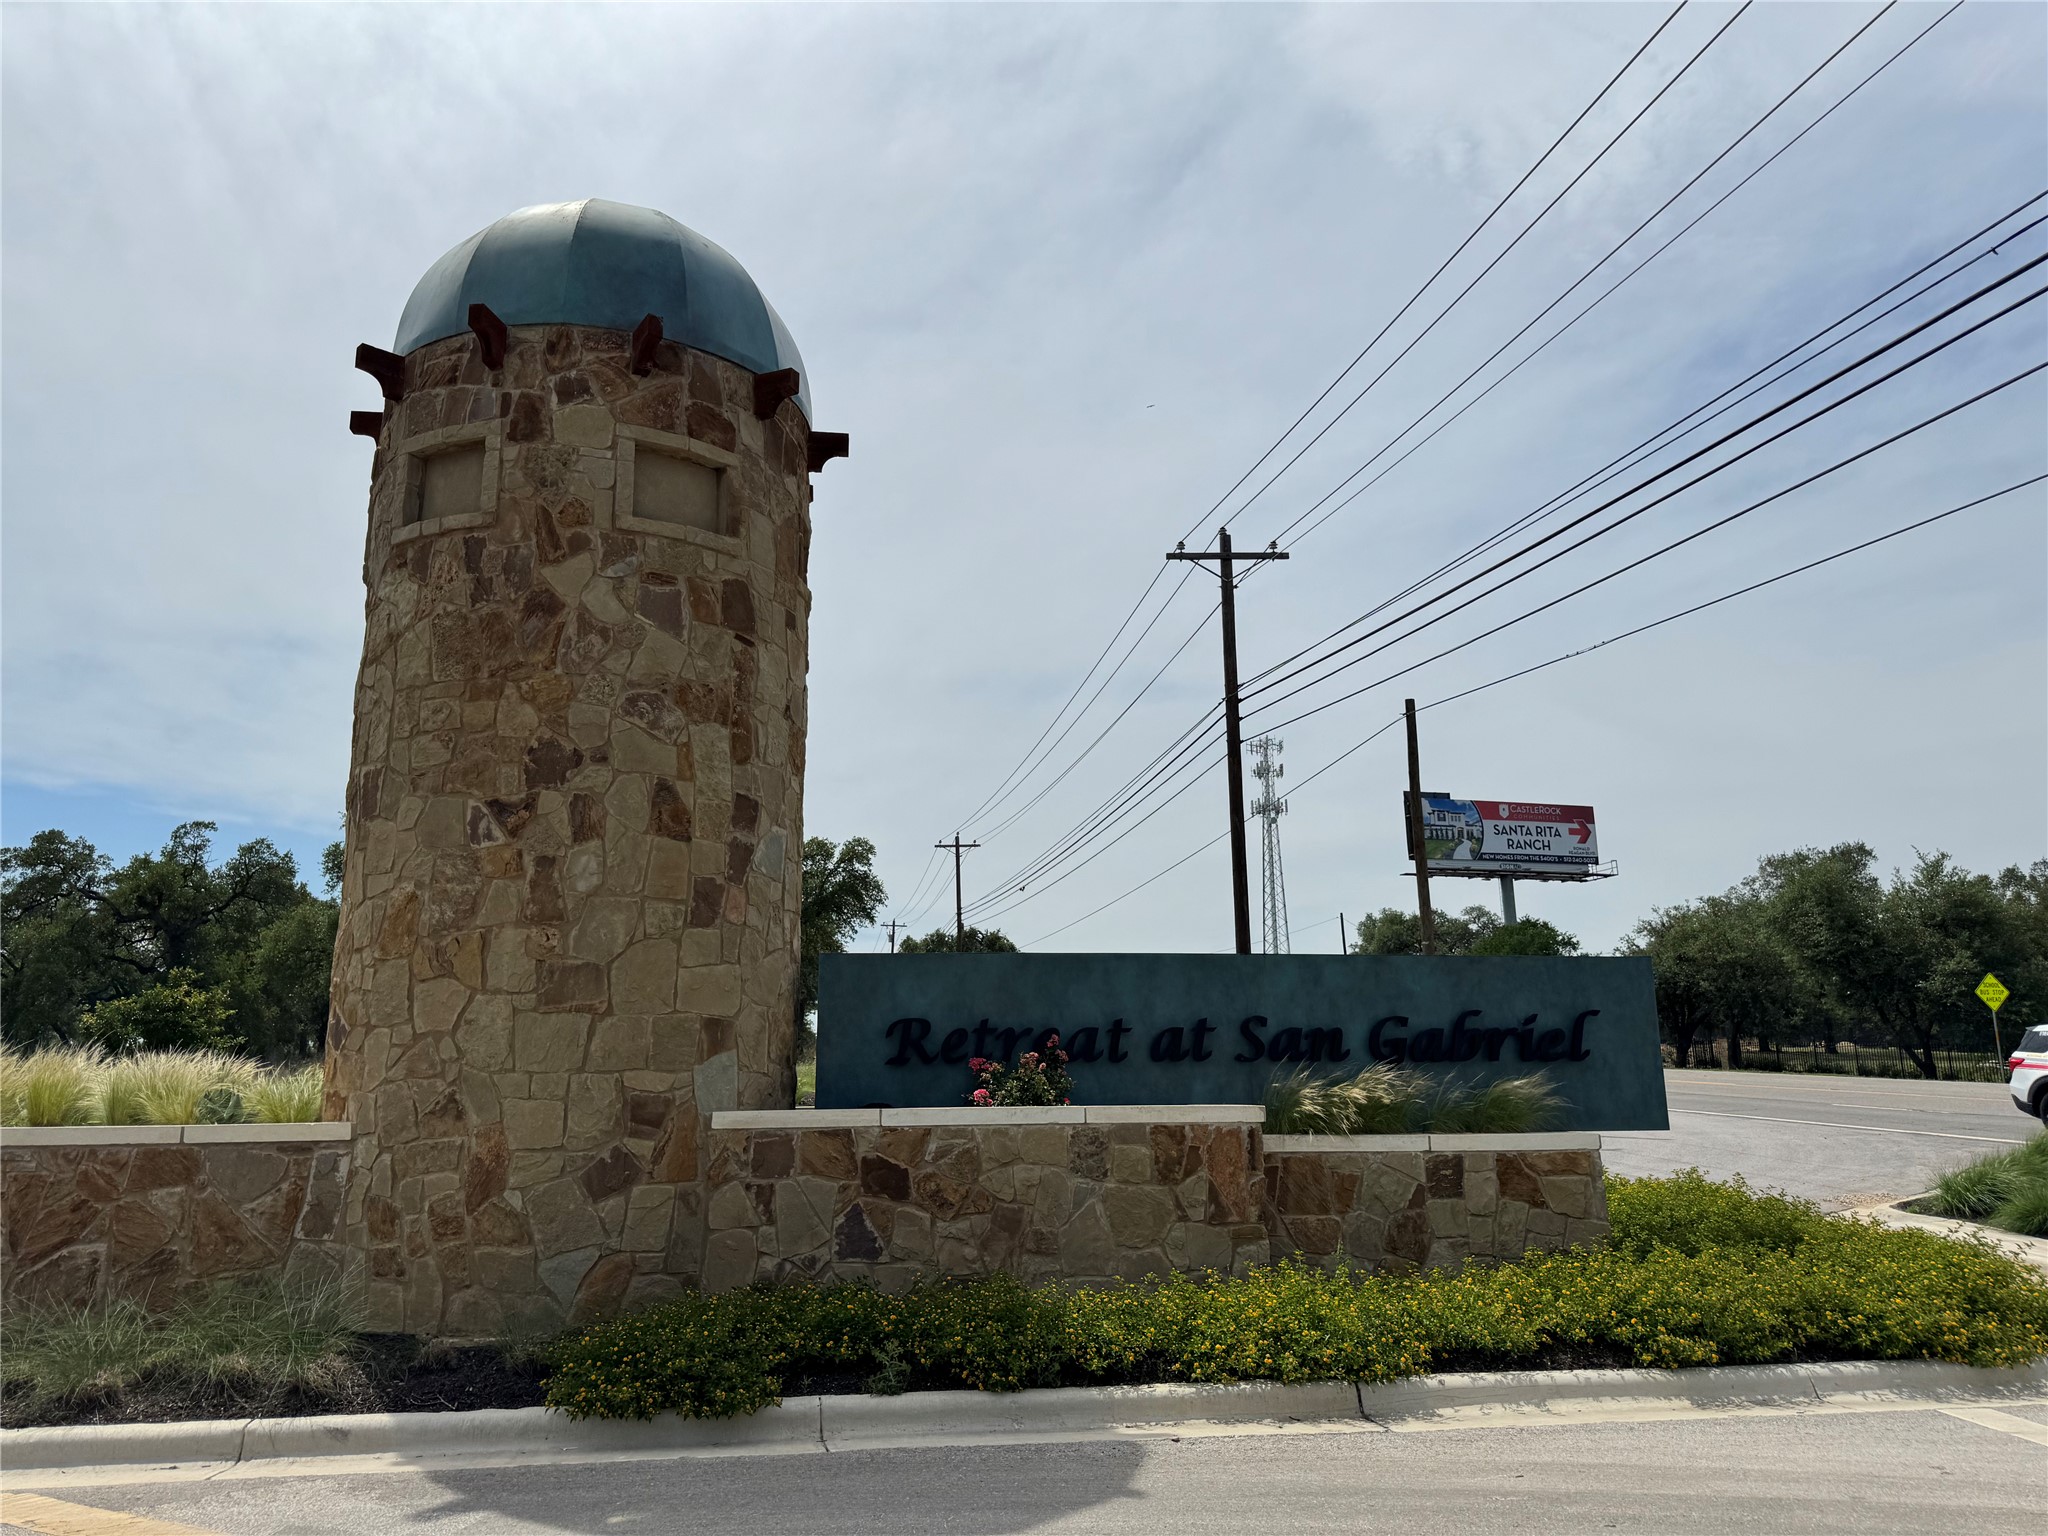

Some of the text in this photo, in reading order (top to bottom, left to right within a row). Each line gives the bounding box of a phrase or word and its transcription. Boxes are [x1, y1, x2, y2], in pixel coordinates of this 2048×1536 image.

[1493, 824, 1562, 838] SANTA RITA
[1507, 838, 1551, 851] RANCH
[1150, 1017, 1217, 1062] at
[1234, 1015, 1350, 1062] San
[1368, 1009, 1600, 1063] Gabriel
